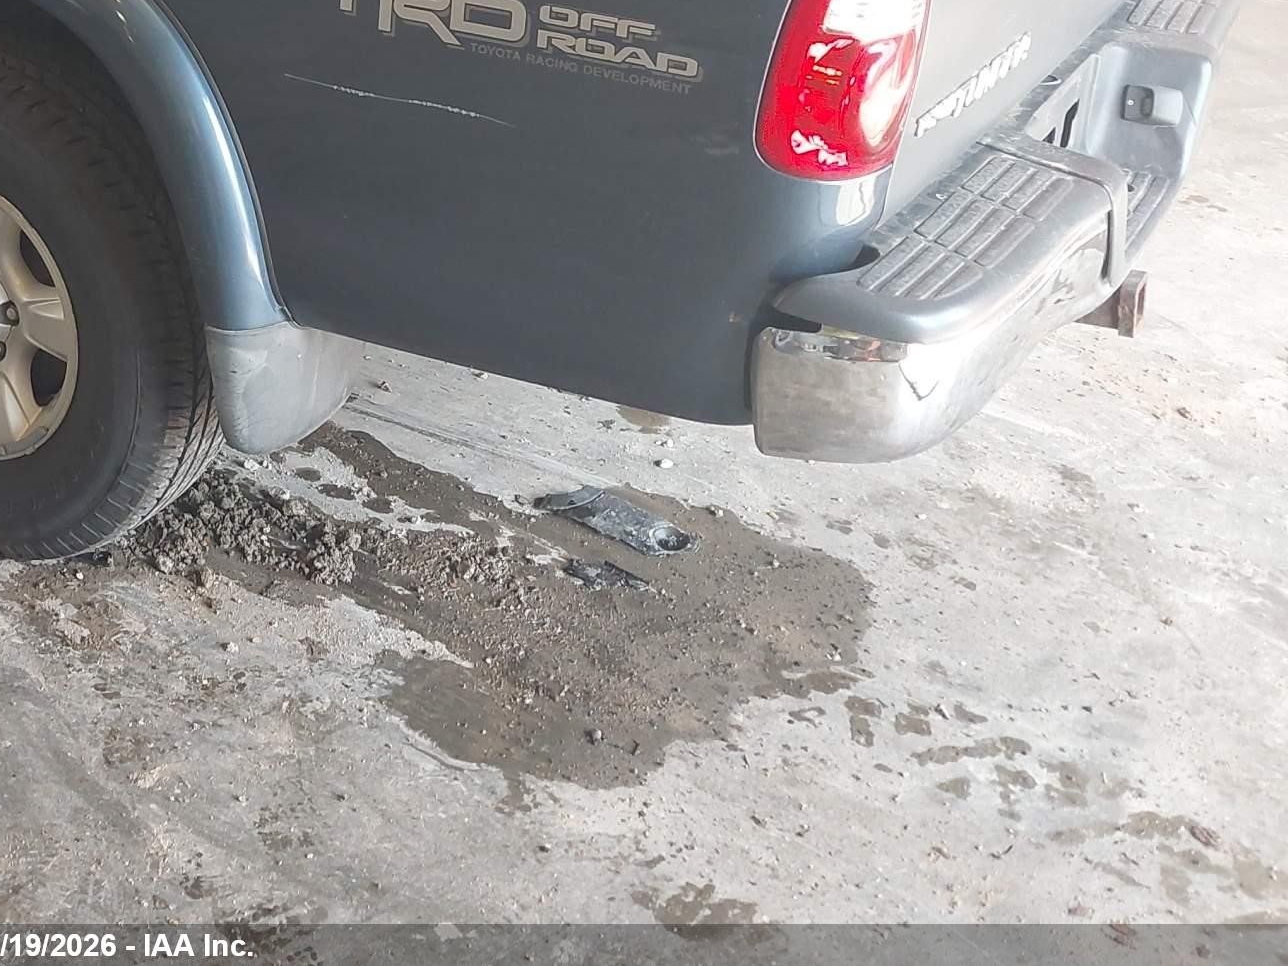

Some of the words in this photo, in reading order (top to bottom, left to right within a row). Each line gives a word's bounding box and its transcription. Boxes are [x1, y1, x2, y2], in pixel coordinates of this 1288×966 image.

[538, 4, 659, 40] OFF
[469, 41, 522, 62] TOYOTA
[525, 52, 579, 74] RACING
[582, 64, 693, 95] DEVELOPMENT
[536, 28, 701, 79] ROAD
